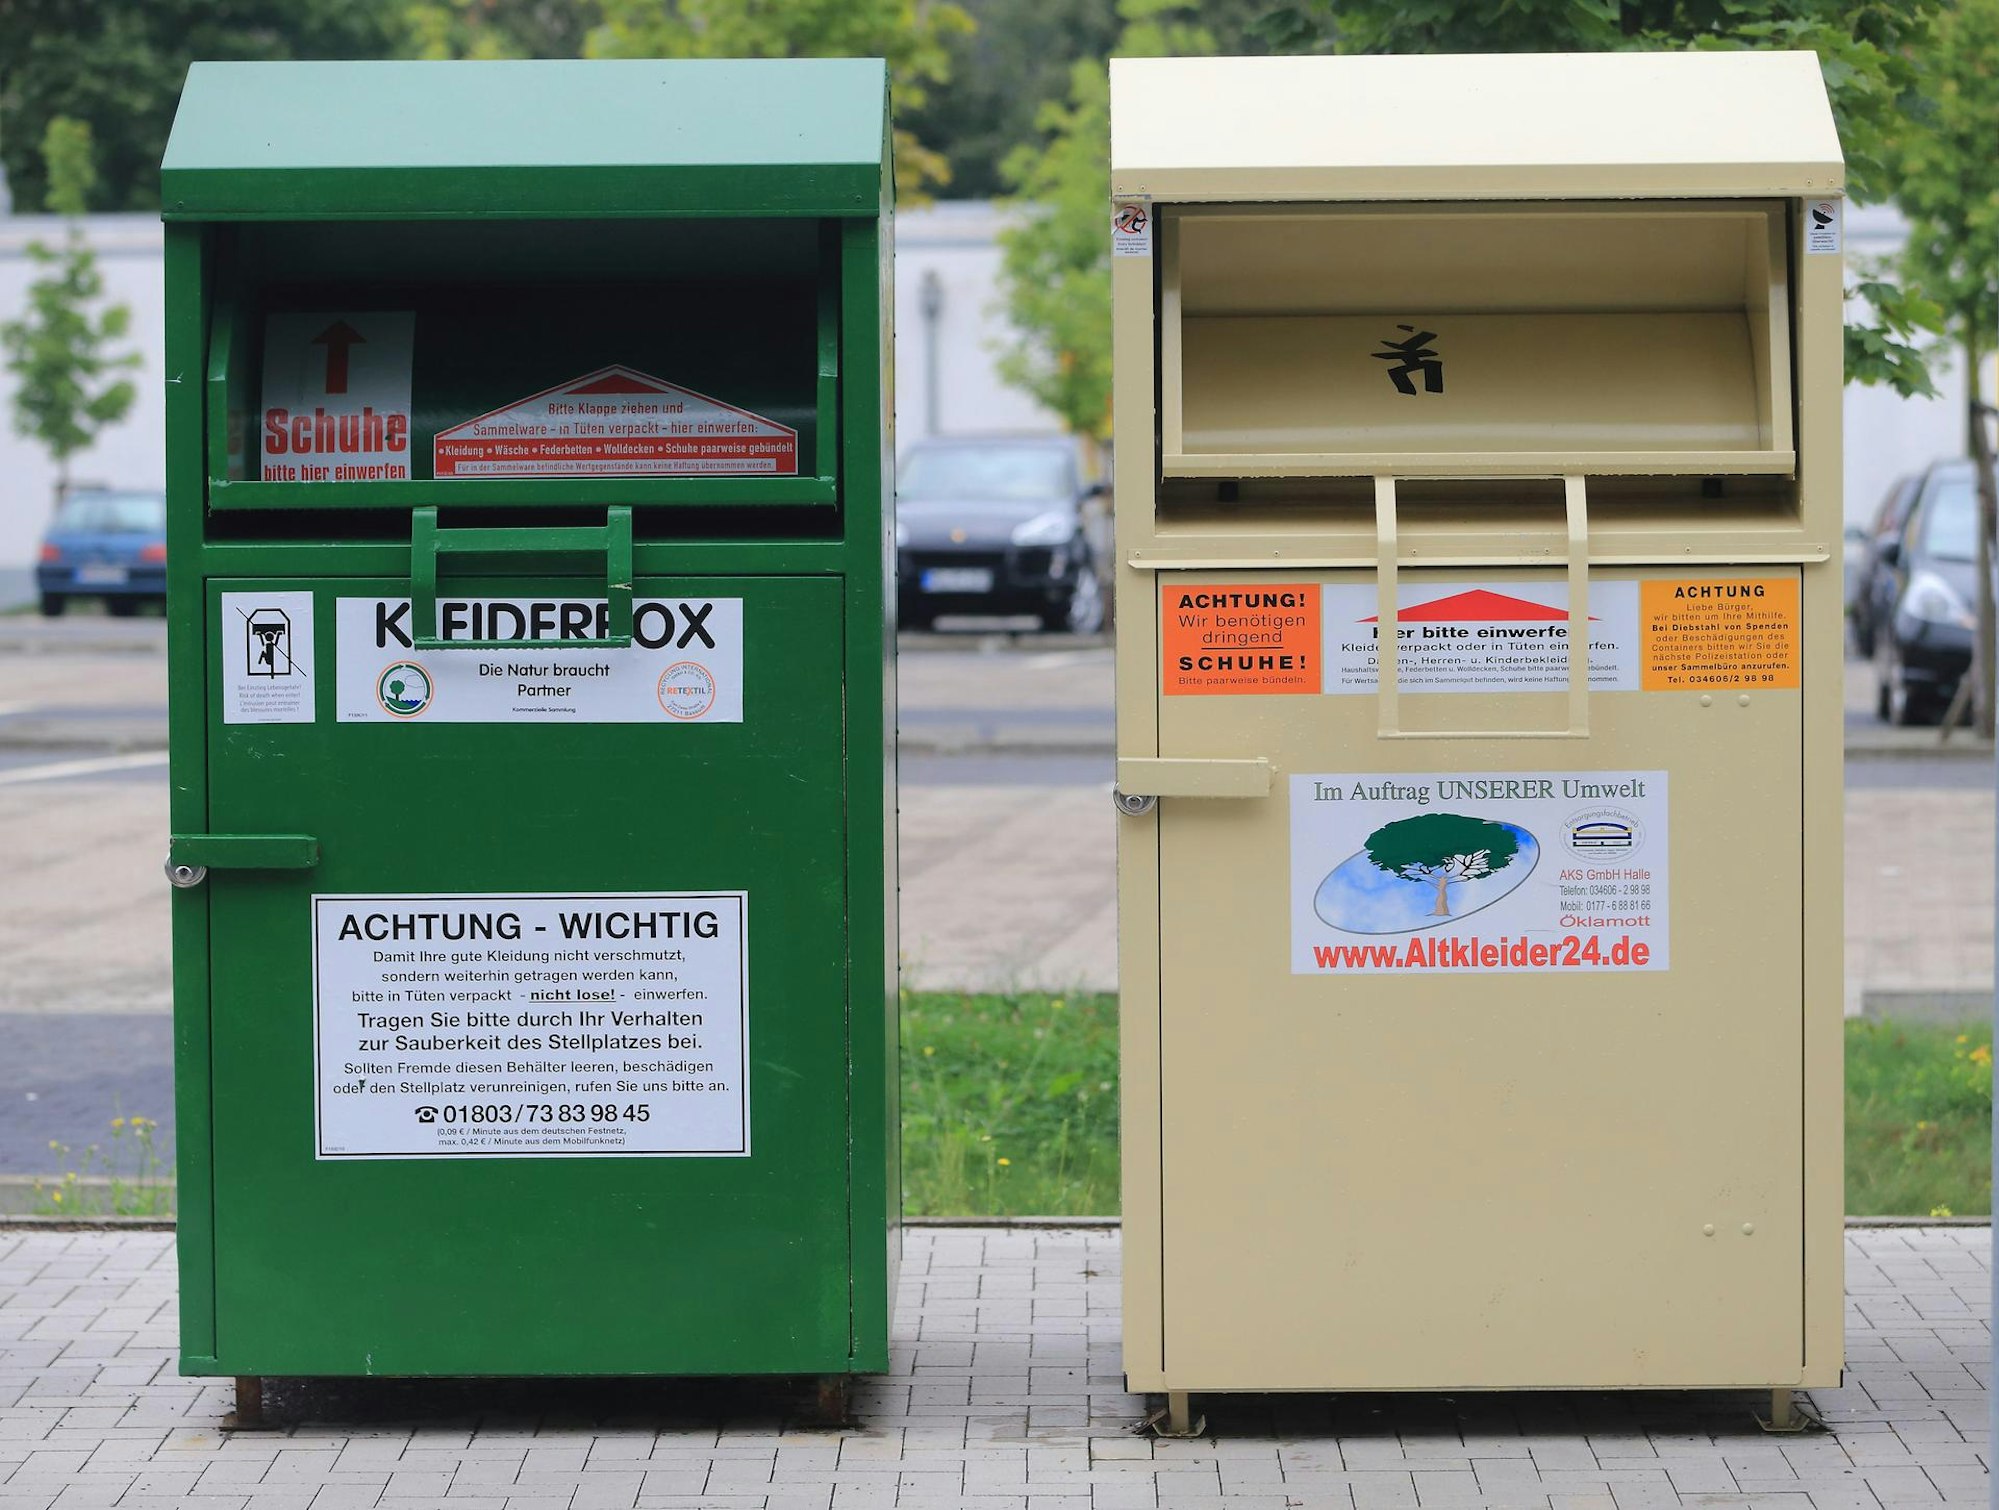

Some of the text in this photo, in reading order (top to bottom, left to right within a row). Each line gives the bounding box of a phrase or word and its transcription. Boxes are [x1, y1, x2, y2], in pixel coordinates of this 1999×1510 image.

[549, 399, 682, 416] Bitte Klappe ziehen und
[263, 405, 408, 453] Schuhe
[472, 420, 760, 437] Sammelware in Tüten verpackt hier einwerfen:
[444, 441, 793, 457] Kleidung Wäsche Federbetten Wolldecken Schuhe paarweise gebündelt
[264, 463, 405, 481] bitte hier einwerfen
[1674, 585, 1765, 598] ACHTUNG
[1179, 593, 1304, 608] ACHTUNG!
[1686, 603, 1714, 612] Liebe
[1178, 613, 1304, 629] Wir benötigen
[1653, 611, 1787, 621] wir bitten um Ihre Mithilfe.
[1422, 625, 1567, 638] bitte einwerfe
[1651, 623, 1668, 632] Bei
[1671, 623, 1720, 632] Diebstahl
[1745, 622, 1789, 631] Spenden
[1202, 630, 1282, 645] dringend
[1655, 632, 1785, 643] oder Beschädigungen des
[1456, 641, 1545, 651] oder in Tüten
[1651, 642, 1789, 652] Containers bitten wir Sie die
[1180, 655, 1305, 670] SCHUHE!
[1653, 651, 1789, 661] nächste Polizeistation oder
[480, 662, 610, 676] Die Natur braucht
[1680, 662, 1738, 671] Sammelbüro
[1740, 662, 1790, 670] anzurufen.
[1178, 675, 1307, 687] Bitte paarweise bündeln.
[1667, 675, 1685, 684] Tel.
[1744, 674, 1756, 682] 98
[1762, 674, 1773, 682] 98
[517, 683, 572, 696] Partner
[1315, 779, 1645, 805] Im Auftrag UNSERER Umwelt
[1559, 867, 1651, 881] AKS GmbH Halle
[1558, 883, 1650, 896] Telefon: 034606 2 98 98
[1559, 900, 1584, 912] Mobil:
[1586, 899, 1605, 911] 0177
[1612, 899, 1617, 911] 6
[339, 913, 520, 940] ACHTUNG
[560, 911, 717, 938] WICHTIG
[1560, 913, 1650, 927] Öklamott
[373, 948, 685, 964] Damit Ihre gute Kleidung nicht verschmutzt,
[1313, 935, 1650, 968] www.Altkleider24.de
[381, 968, 678, 983] sondern weiterhin getragen werden kann,
[352, 987, 708, 1003] bitte in Tüten verpackt nicht lose! einwerfen.
[358, 1010, 702, 1031] Tragen Sie bitte durch Ihr Verhalten
[358, 1033, 702, 1051] zur Sauberkeit des Stellplatzes bei.
[343, 1059, 713, 1074] Sollten Fremde diesen Behälter leeren, beschädigen
[332, 1079, 729, 1095] oder den Stellplatz verunreinigen, rufen Sie uns bitte an.
[558, 1104, 585, 1122] 83
[591, 1104, 618, 1122] 98
[623, 1104, 650, 1121] 45
[437, 1127, 458, 1137] (0,09
[472, 1127, 502, 1135] Minute
[520, 1127, 540, 1135] dem
[541, 1127, 587, 1135] deutschen
[587, 1126, 627, 1135] Festnetz,
